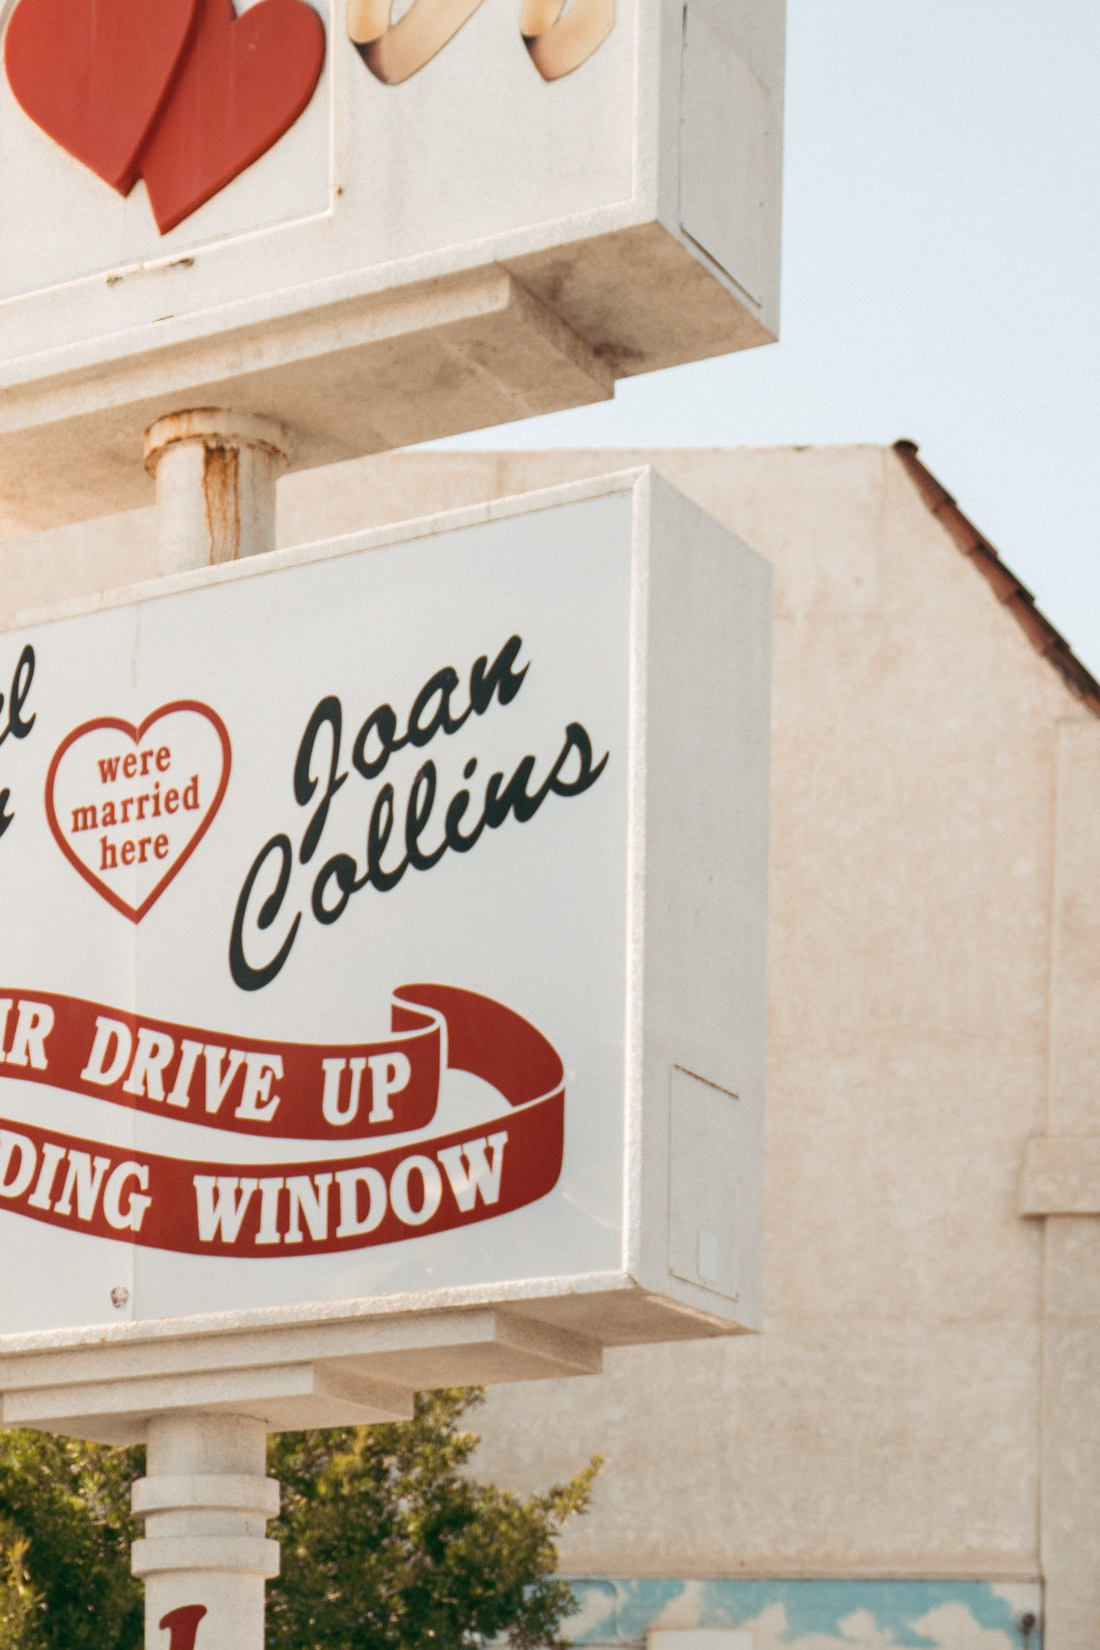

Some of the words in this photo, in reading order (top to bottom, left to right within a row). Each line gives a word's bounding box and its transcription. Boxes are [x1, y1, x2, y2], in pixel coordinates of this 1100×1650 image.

[71, 774, 200, 833] married
[97, 746, 171, 784] were
[293, 635, 530, 865] Joan
[99, 833, 170, 871] here
[228, 722, 610, 992] Collins
[80, 1015, 285, 1122] DRIVE
[321, 1051, 412, 1127] UP
[192, 1130, 509, 1246] WINDOW
